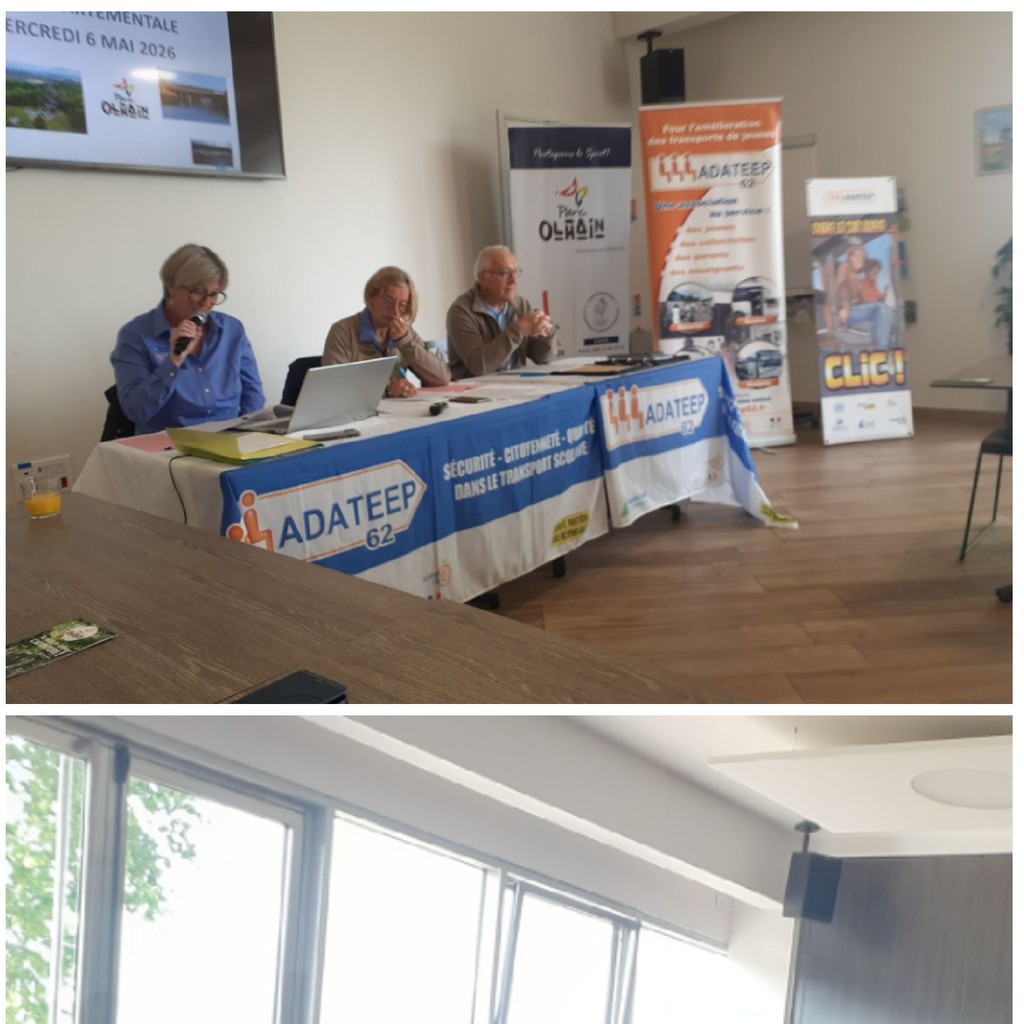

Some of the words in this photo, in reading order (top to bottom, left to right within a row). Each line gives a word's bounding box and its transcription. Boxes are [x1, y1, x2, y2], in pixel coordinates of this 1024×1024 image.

[86, 32, 97, 46] 6
[101, 35, 135, 53] MAI
[140, 42, 176, 60] 2026
[647, 138, 666, 146] des
[669, 133, 723, 145] transports
[726, 133, 740, 141] de
[662, 123, 686, 134] Pour
[698, 161, 772, 180] ADATEEP
[557, 204, 587, 218] Parc
[646, 393, 705, 425] ADATEEP
[681, 421, 695, 434] 62
[442, 448, 496, 481] SÉCURITÉ
[454, 477, 486, 501] DANS
[487, 473, 499, 491] LE
[499, 455, 552, 487] TRANSPORT
[278, 480, 416, 548] ADATEEP
[366, 524, 393, 547] 62
